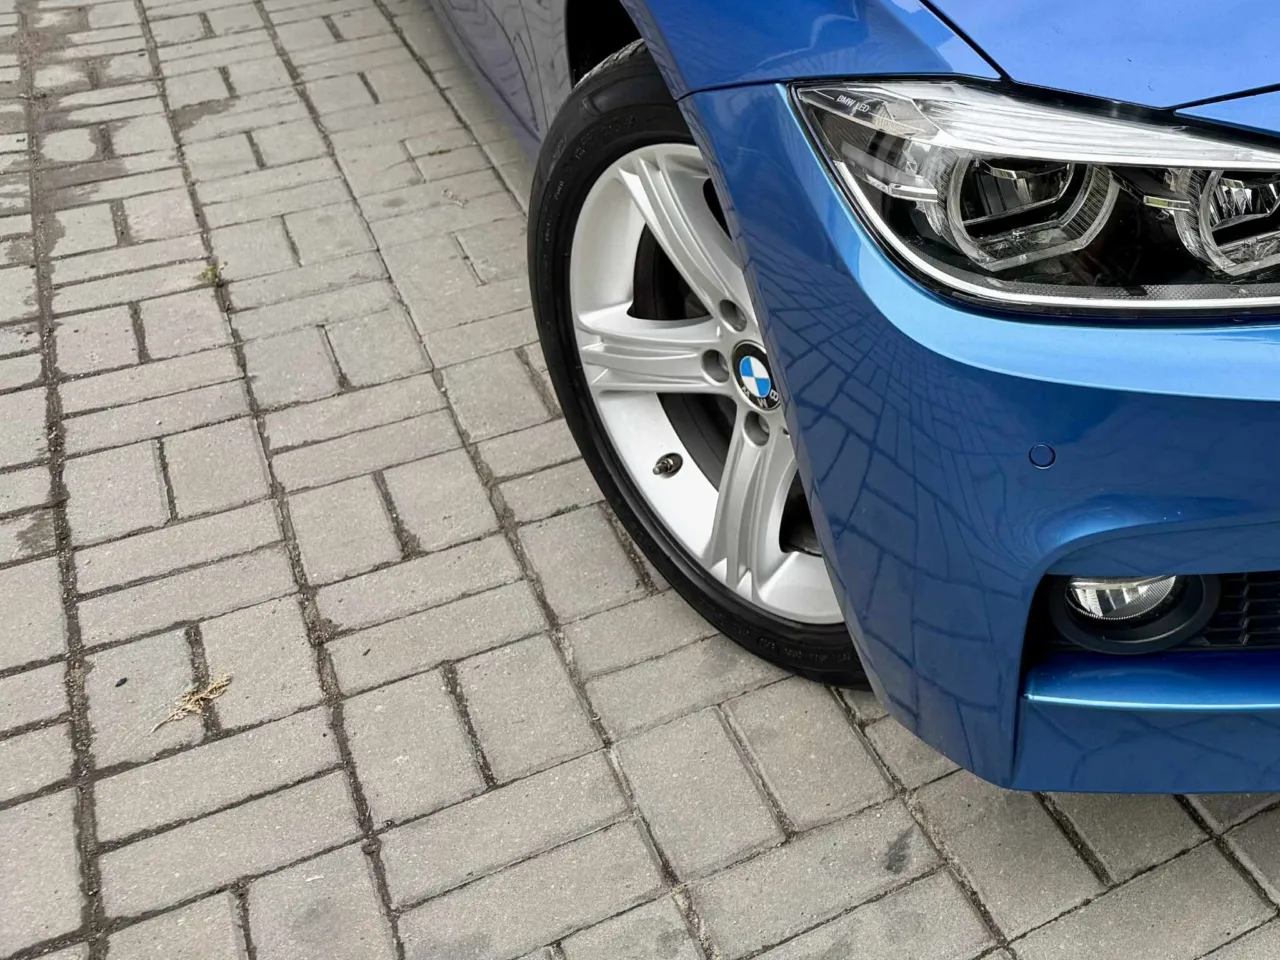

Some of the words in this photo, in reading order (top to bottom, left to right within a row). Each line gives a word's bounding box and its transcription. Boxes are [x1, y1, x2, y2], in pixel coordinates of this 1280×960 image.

[836, 94, 857, 107] BMW
[855, 101, 870, 113] LED
[741, 385, 780, 409] BMW
